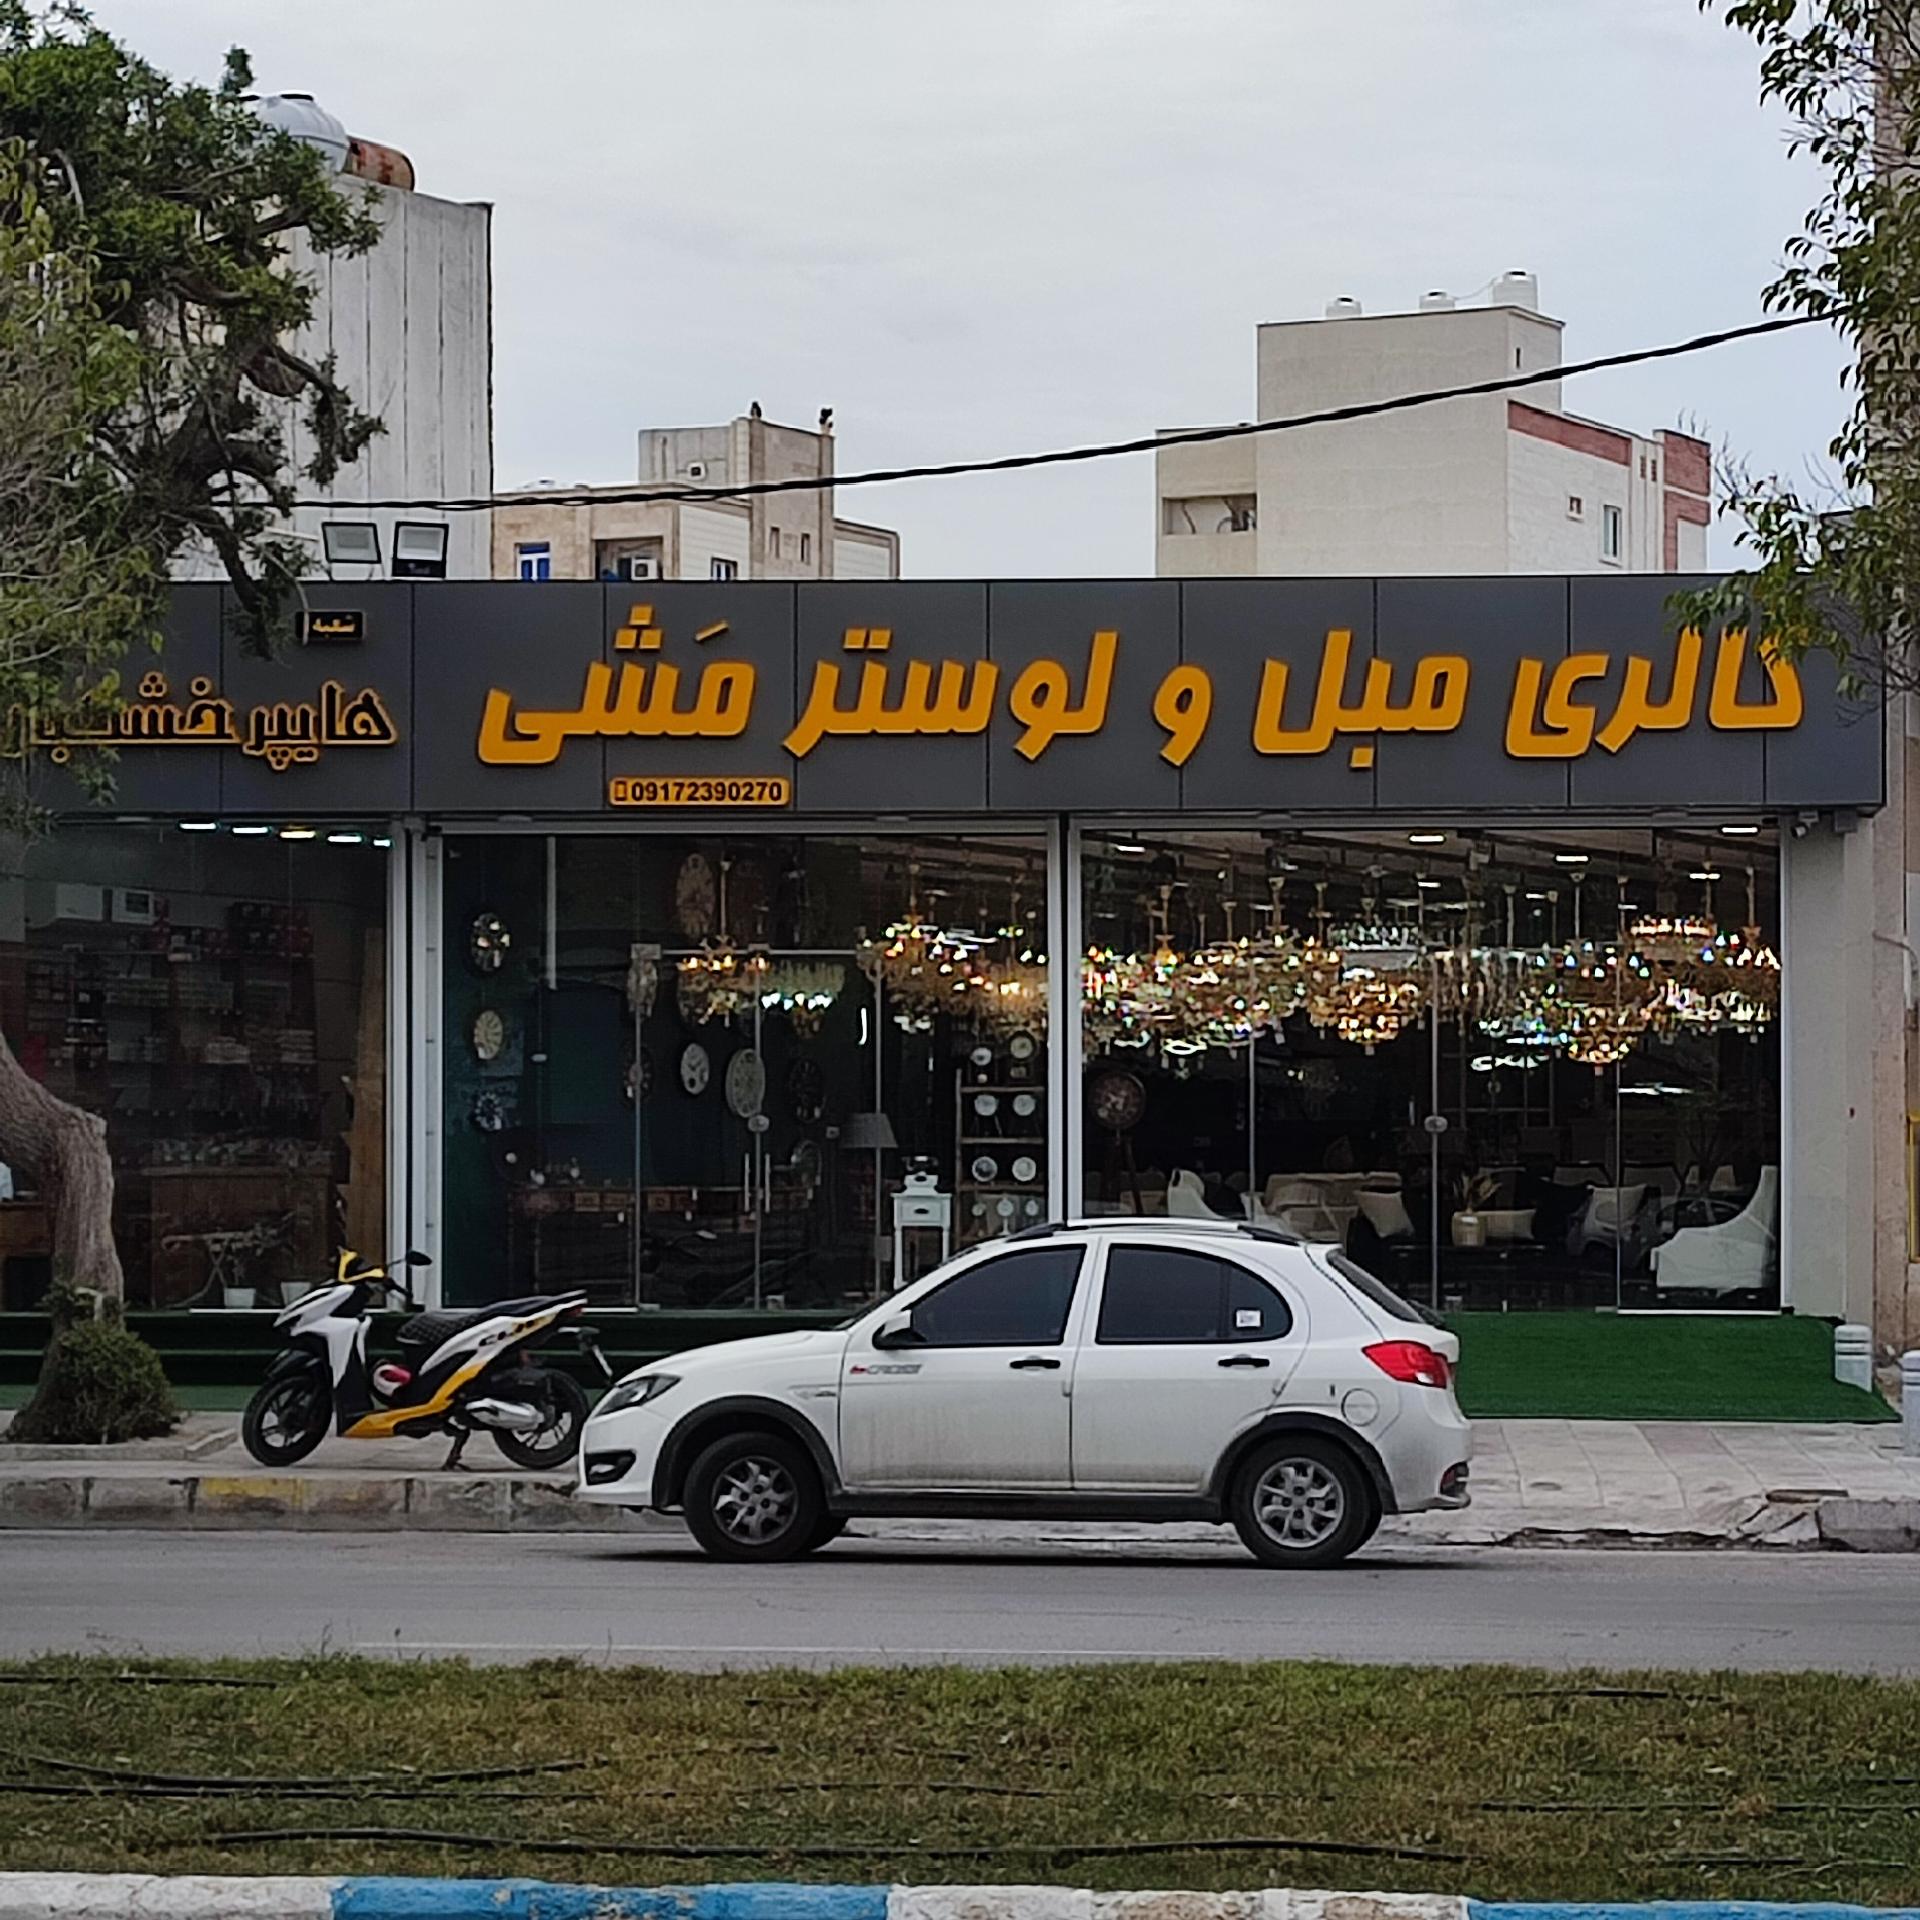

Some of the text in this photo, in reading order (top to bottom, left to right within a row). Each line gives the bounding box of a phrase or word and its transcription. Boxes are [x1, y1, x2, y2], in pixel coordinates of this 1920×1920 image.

[242, 679, 397, 771] هایپر
[783, 628, 1118, 761] لوستر
[1153, 664, 1212, 767] و
[1253, 628, 1469, 769] مبل
[631, 781, 783, 802] 09172390270
